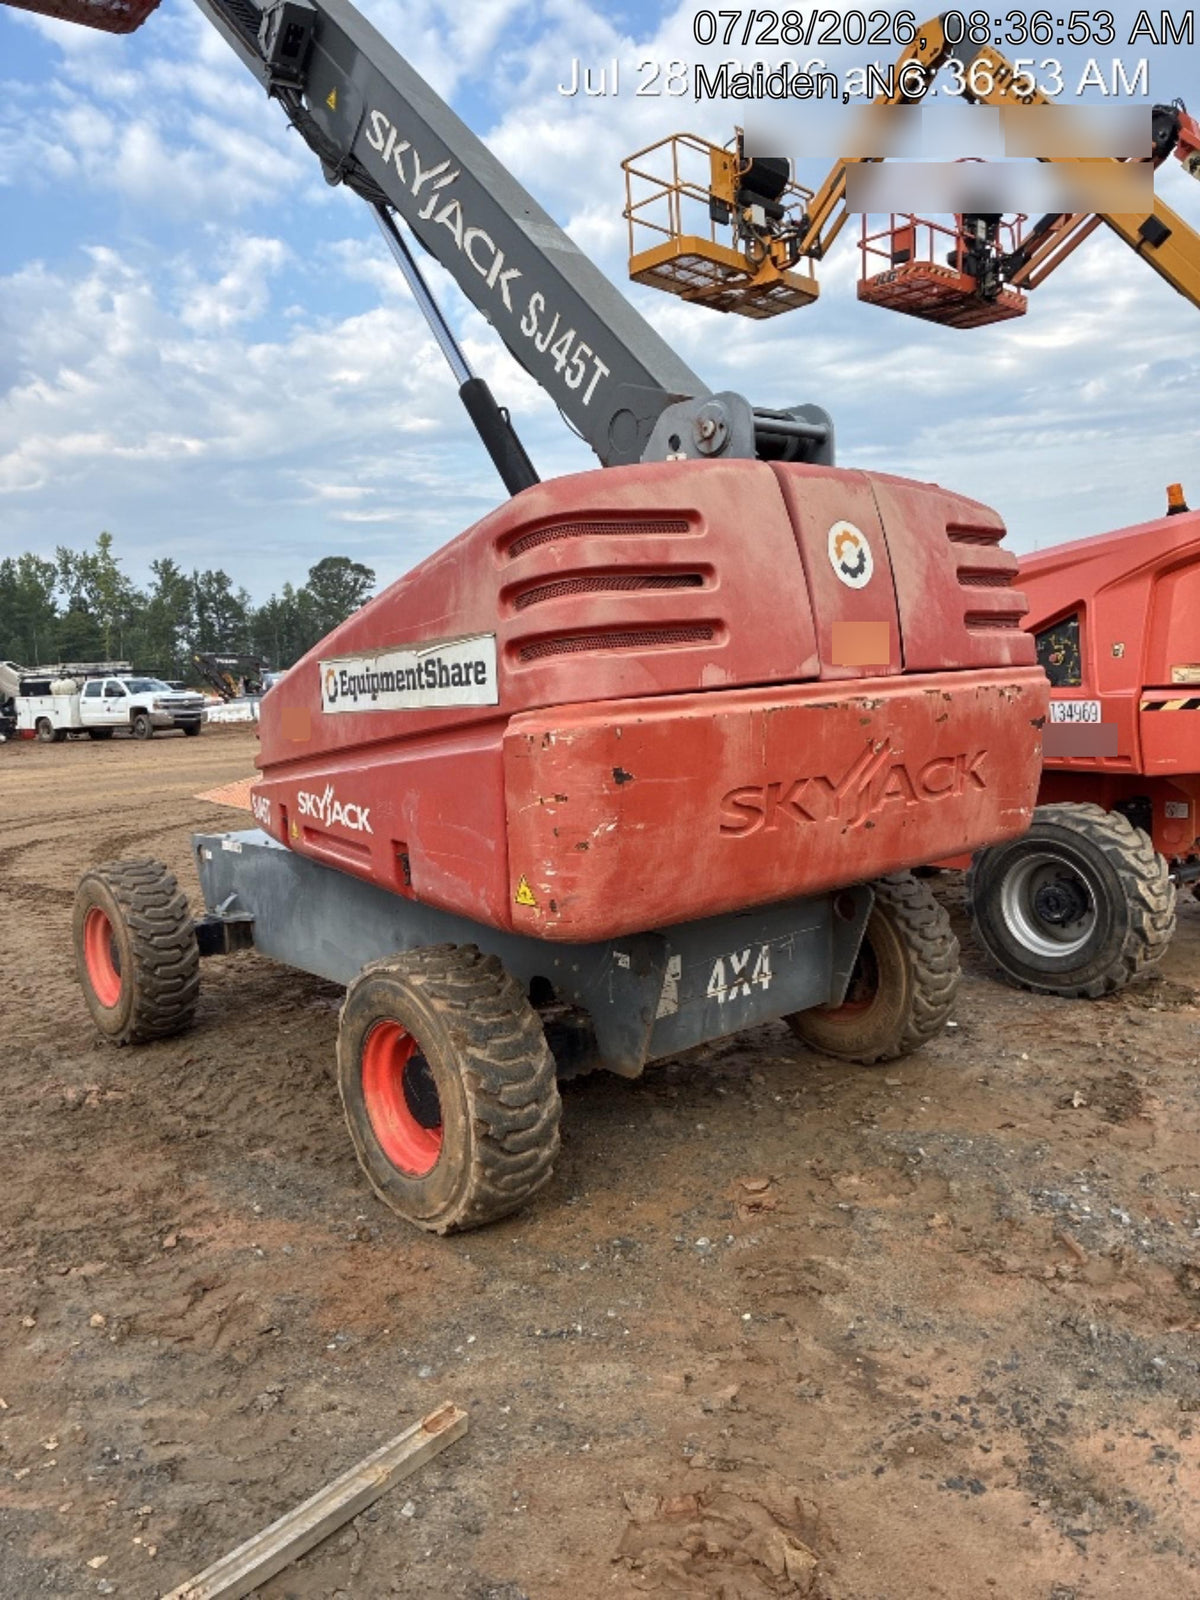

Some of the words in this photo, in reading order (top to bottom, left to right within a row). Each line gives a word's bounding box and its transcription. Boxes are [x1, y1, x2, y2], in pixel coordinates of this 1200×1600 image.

[365, 109, 523, 313] SKYJACK
[520, 290, 610, 406] SJ45T
[339, 657, 487, 701] EquipmentShare
[298, 784, 374, 834] SKYJACK
[719, 737, 989, 838] SKYJACK
